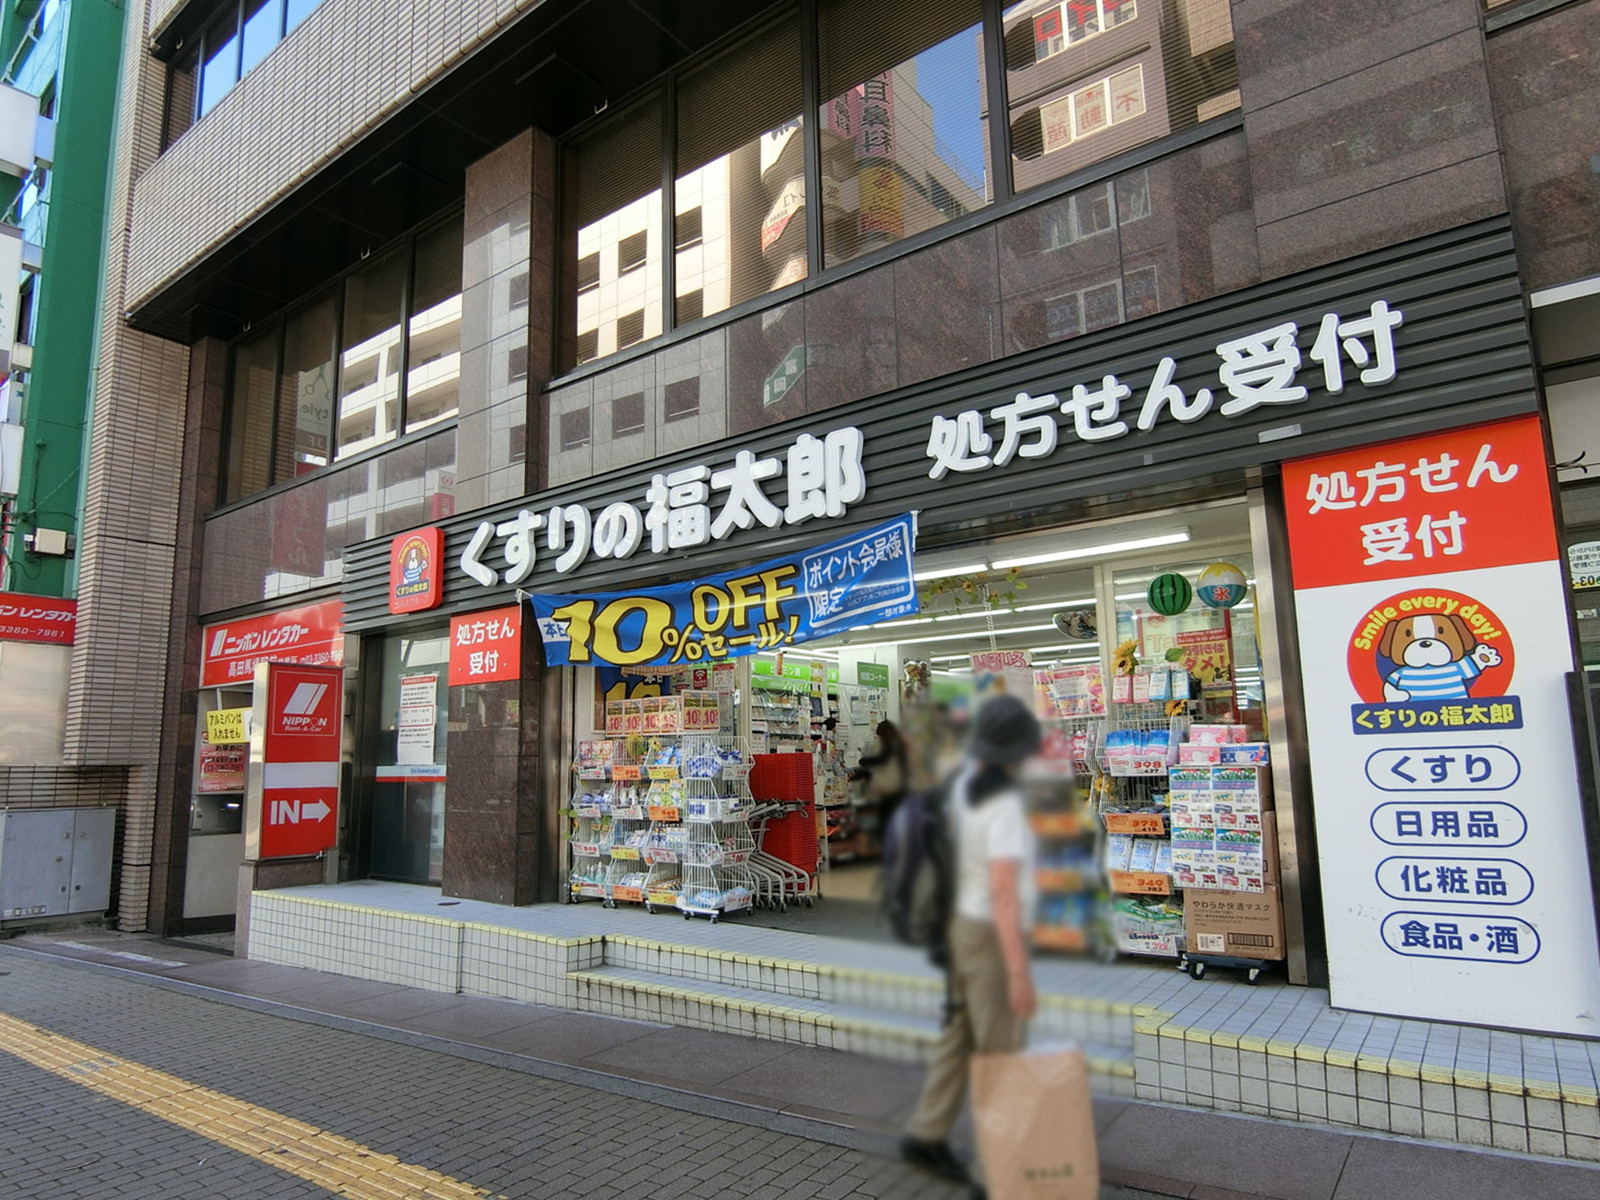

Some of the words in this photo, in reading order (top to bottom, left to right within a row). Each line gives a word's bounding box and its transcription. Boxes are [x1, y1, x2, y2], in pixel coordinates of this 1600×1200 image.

[926, 300, 1404, 481] 処方せん受付
[1305, 443, 1519, 515] 処方せん
[460, 427, 867, 589] くすりの福太郎
[1360, 510, 1467, 566] 受付
[809, 529, 904, 589] ポイント会員様
[692, 564, 800, 634] OFF
[814, 586, 845, 620] 限定
[1213, 586, 1231, 601] 氷
[456, 616, 516, 647] 処方せん
[1354, 606, 1398, 650] Smile
[1398, 596, 1460, 615] every
[1459, 604, 1502, 641] day!
[468, 649, 500, 676] 受付
[770, 664, 800, 677] ビミン剤
[283, 716, 328, 726] NIPPON
[1355, 703, 1515, 729] くすりの福太郎
[1390, 753, 1493, 785] くすり
[270, 800, 300, 825] IN
[1395, 810, 1500, 839] 日用品
[1400, 864, 1508, 897] 化粧品
[1193, 900, 1271, 912] やわらか快適マスク
[1399, 919, 1520, 955] 食品・酒
